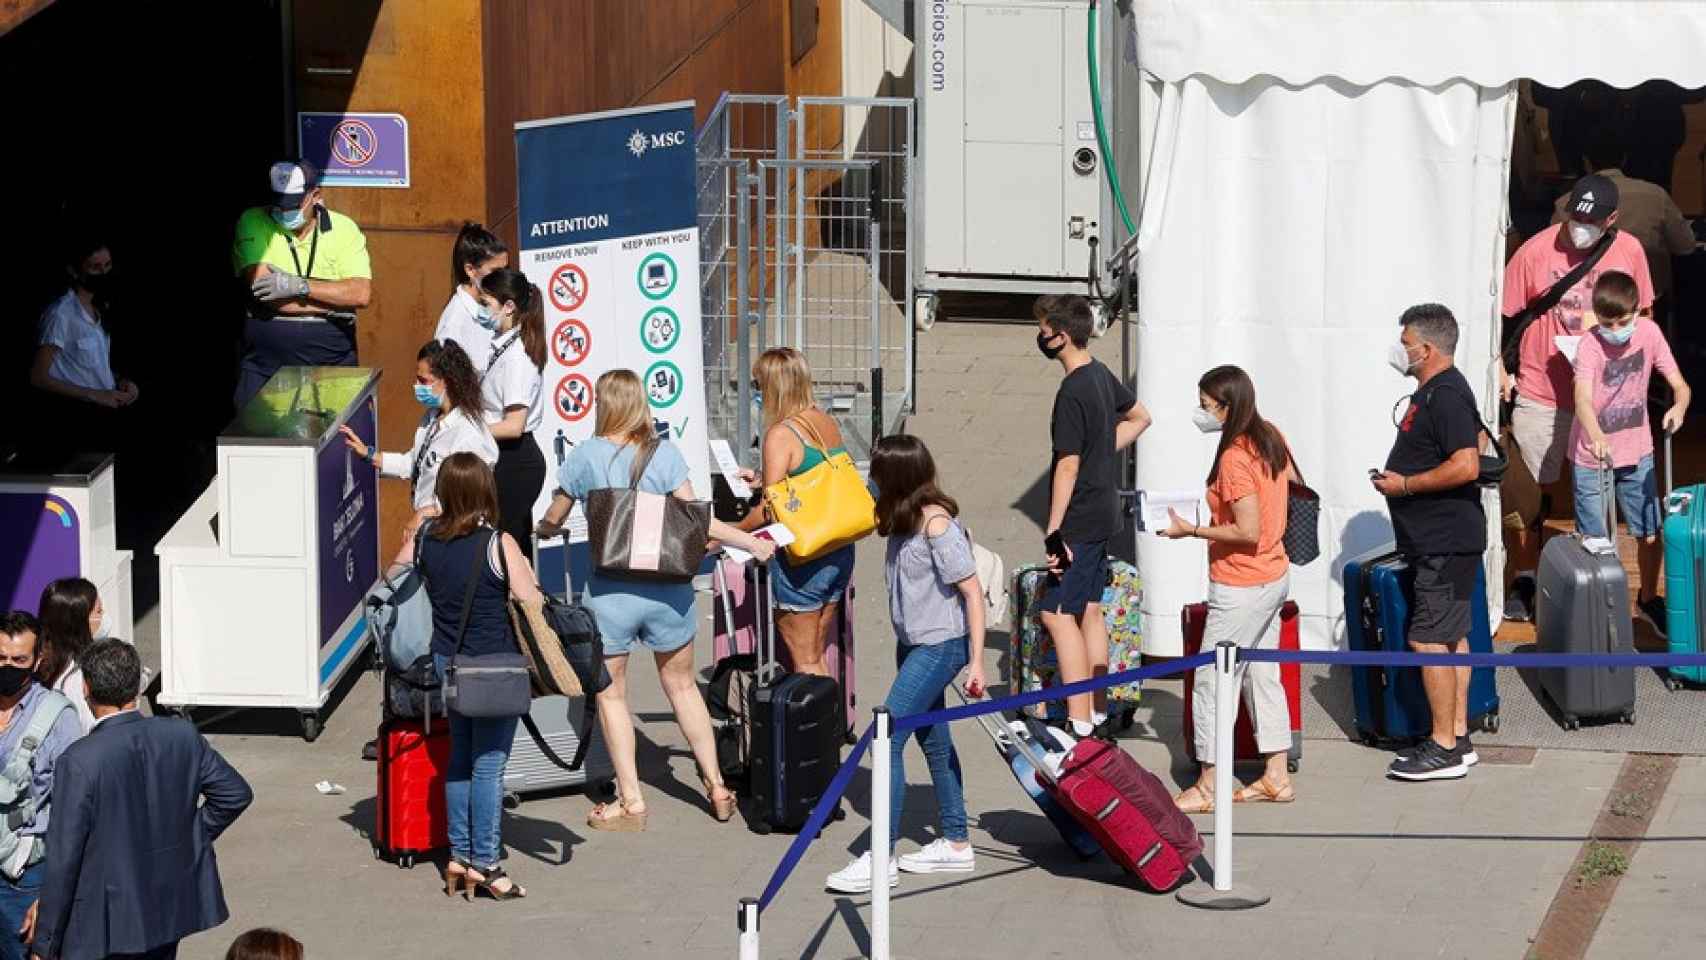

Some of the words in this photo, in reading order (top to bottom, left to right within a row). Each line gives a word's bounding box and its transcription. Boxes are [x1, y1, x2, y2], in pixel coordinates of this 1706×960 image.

[650, 130, 685, 149] MSC
[530, 213, 609, 237] ATTENTION
[621, 238, 643, 249] KEEP
[643, 235, 669, 247] WITH
[670, 231, 691, 243] YOU
[534, 246, 572, 262] REMOVE
[574, 246, 598, 257] NOW
